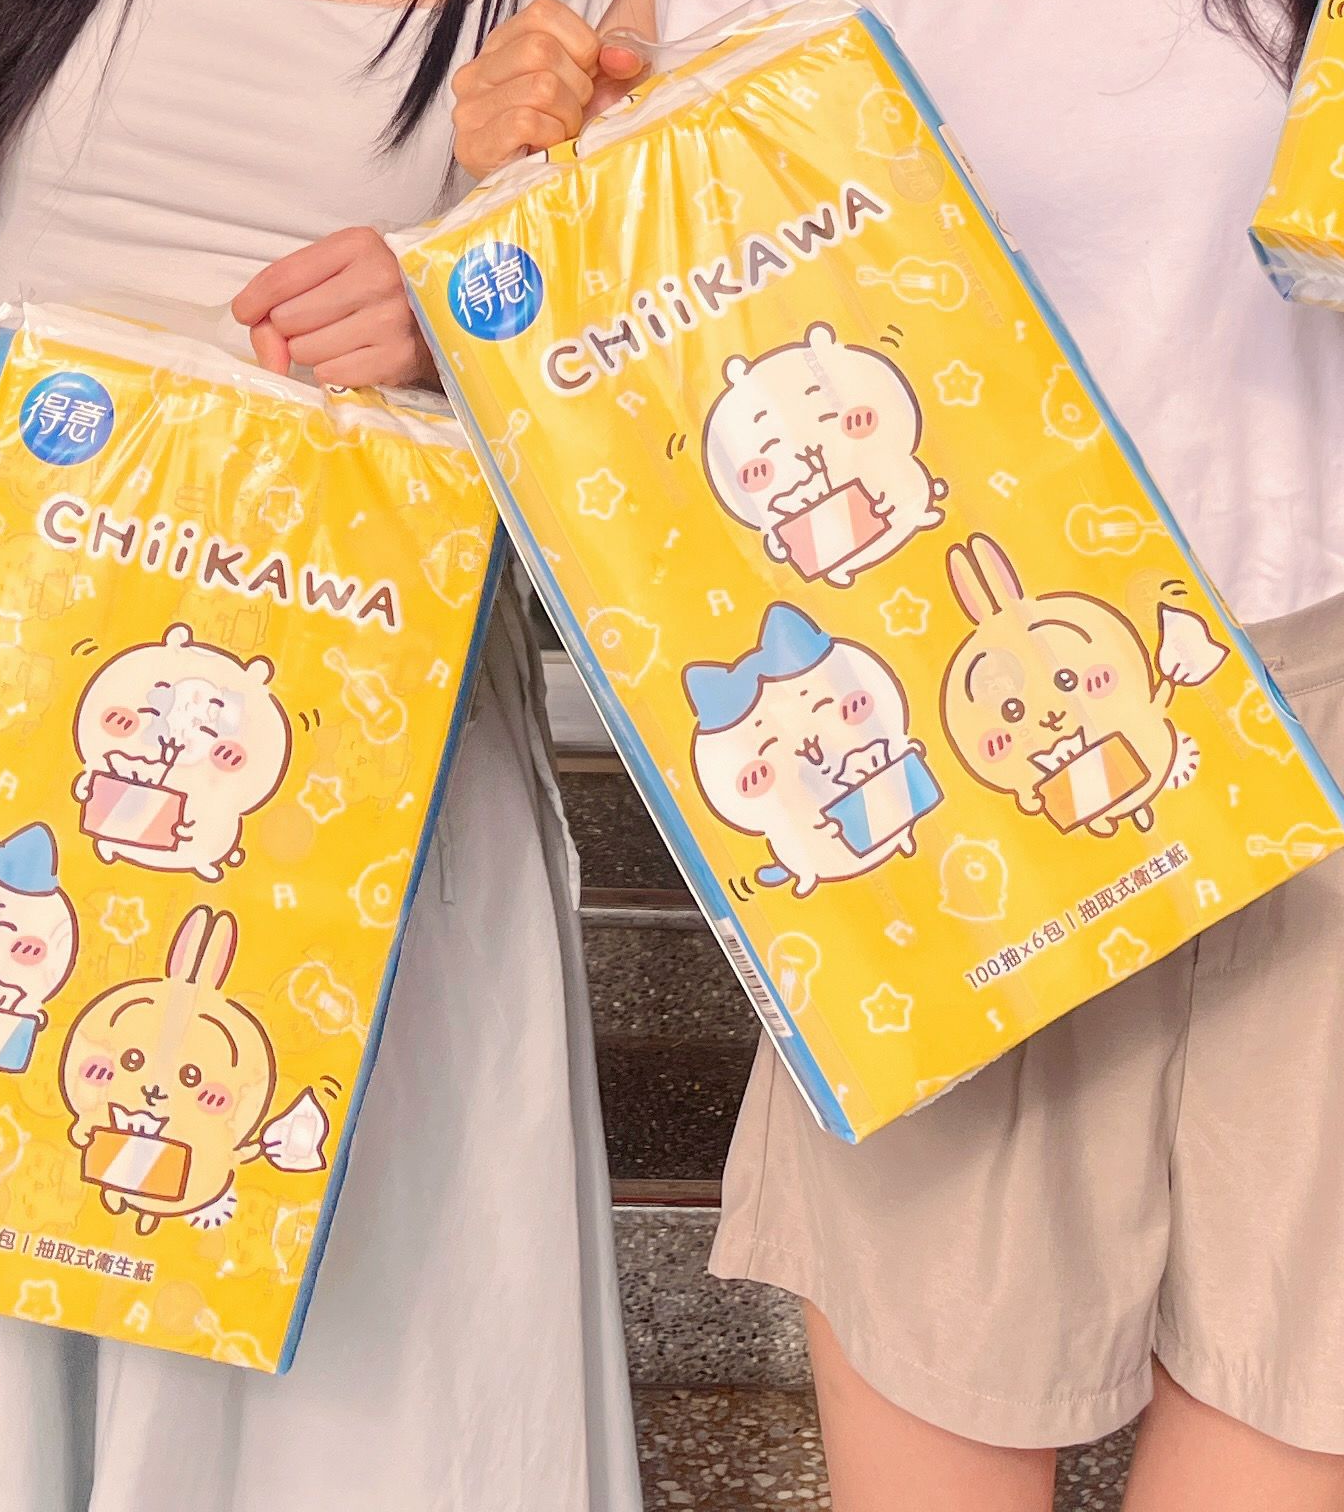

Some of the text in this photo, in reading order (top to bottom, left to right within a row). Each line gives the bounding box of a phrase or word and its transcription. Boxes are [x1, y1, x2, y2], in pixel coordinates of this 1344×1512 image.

[456, 259, 532, 324] 得意
[24, 395, 109, 445] 得意
[1076, 841, 1189, 926] 抽取式衛生紙
[36, 1235, 155, 1284] 抽取式衛生紙
